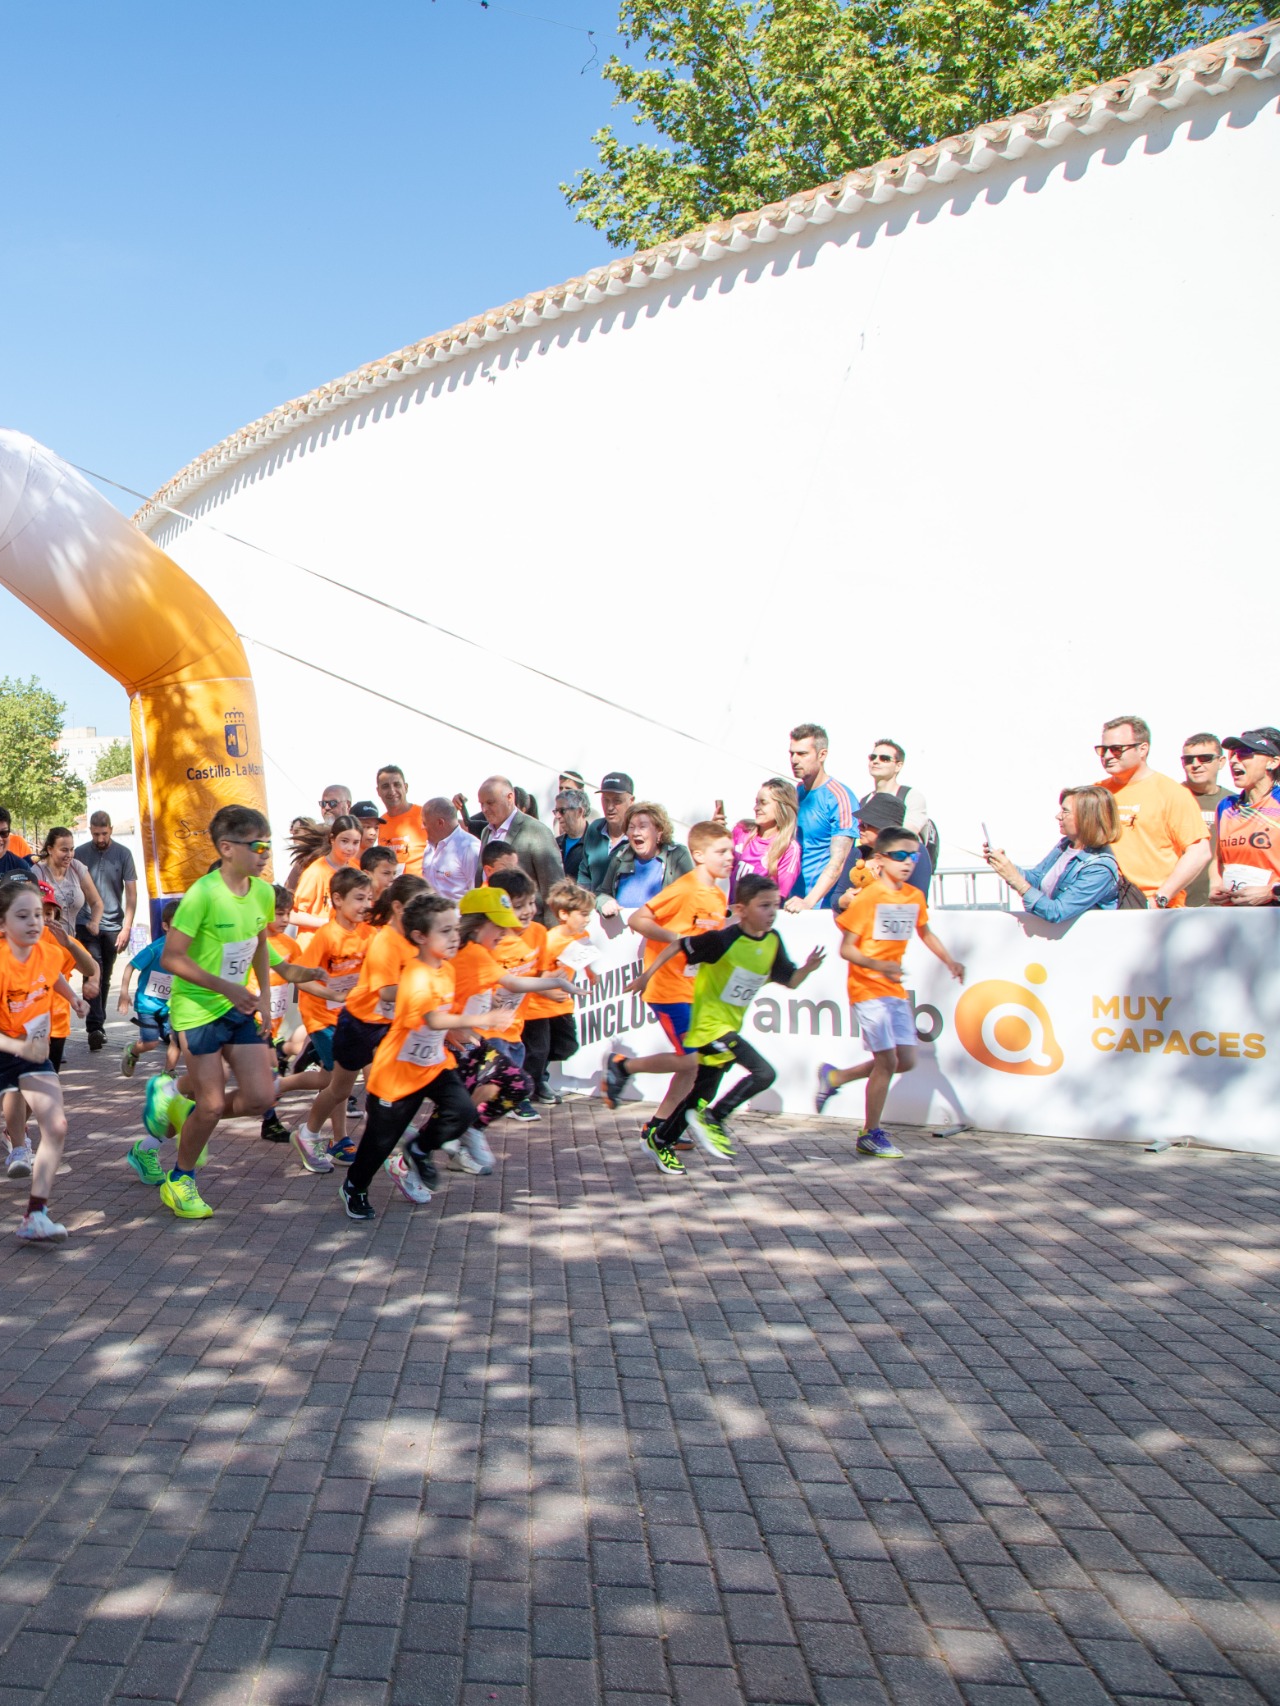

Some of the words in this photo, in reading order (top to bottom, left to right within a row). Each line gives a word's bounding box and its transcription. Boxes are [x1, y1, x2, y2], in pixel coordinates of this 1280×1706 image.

[881, 920, 912, 933] 5073
[152, 983, 171, 995] 109
[753, 990, 944, 1043] amb
[1092, 995, 1172, 1021] MUY
[1091, 1027, 1267, 1059] CAPACES
